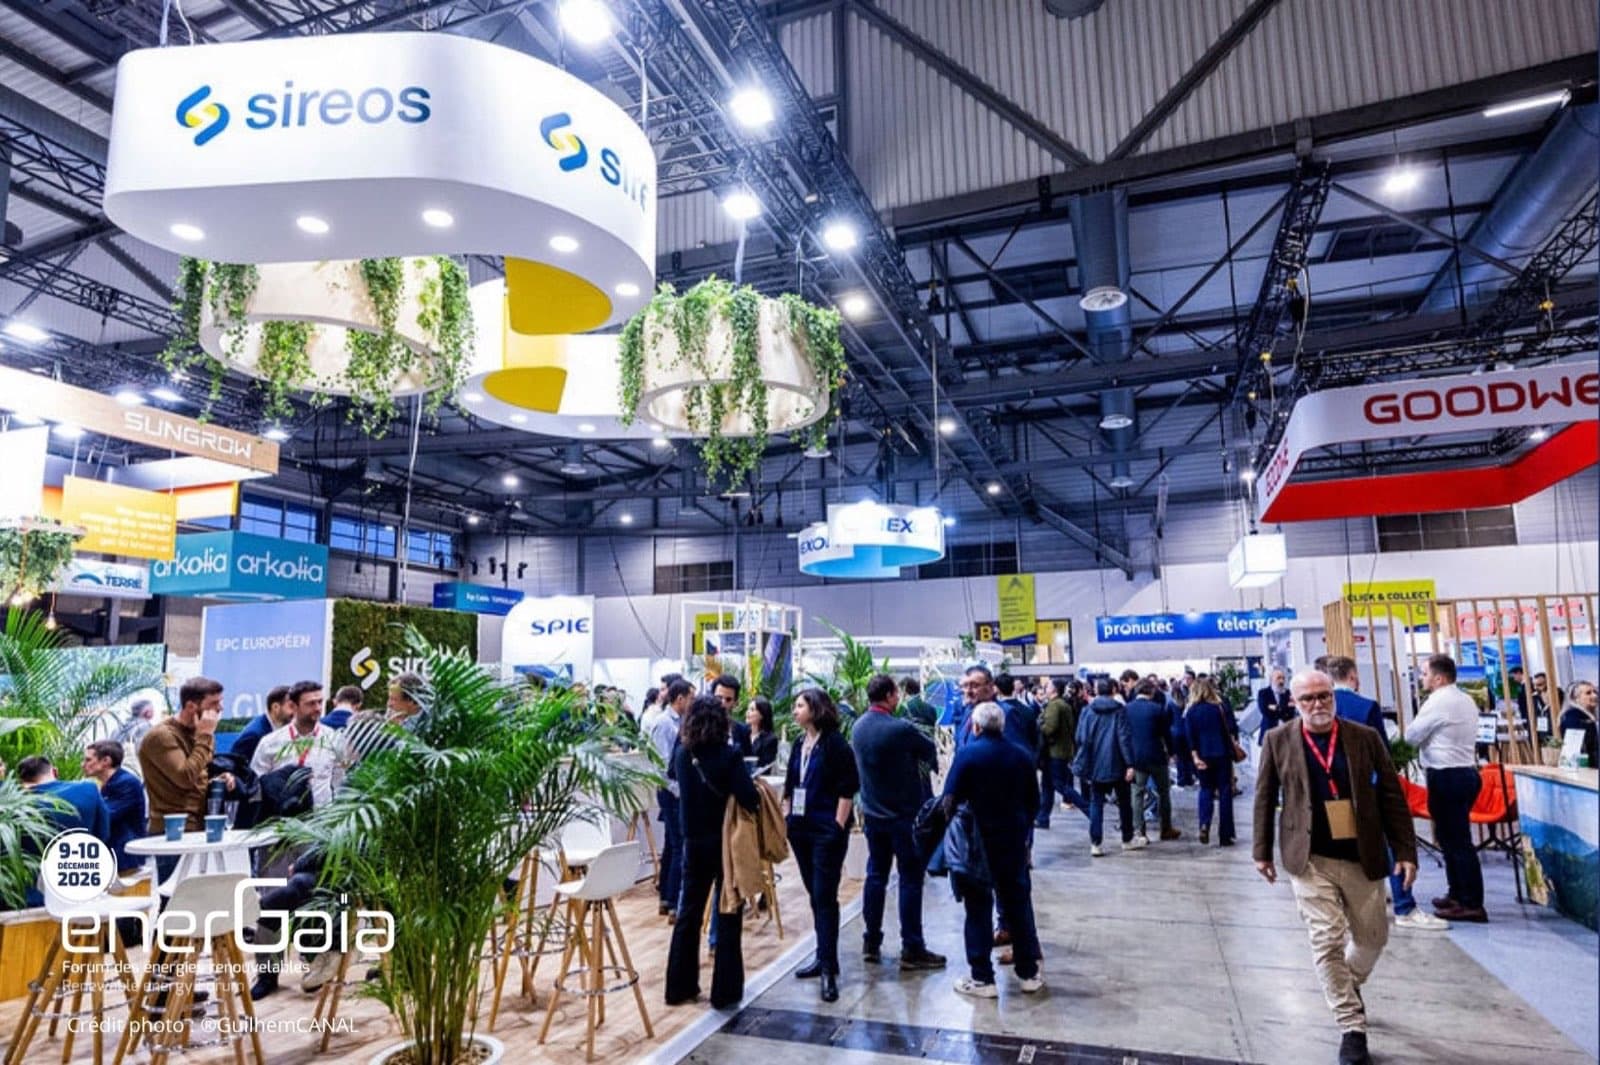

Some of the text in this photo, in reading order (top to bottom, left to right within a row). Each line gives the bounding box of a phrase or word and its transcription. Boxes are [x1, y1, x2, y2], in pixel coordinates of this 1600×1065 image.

[246, 81, 431, 129] sireos
[124, 411, 251, 459] SUNGROW
[153, 547, 227, 578] arkolia
[237, 551, 323, 584] arkolia
[1387, 591, 1430, 600] COLLECT
[531, 617, 591, 635] SPIE
[1104, 620, 1174, 639] pronutec
[216, 637, 240, 652] EPC
